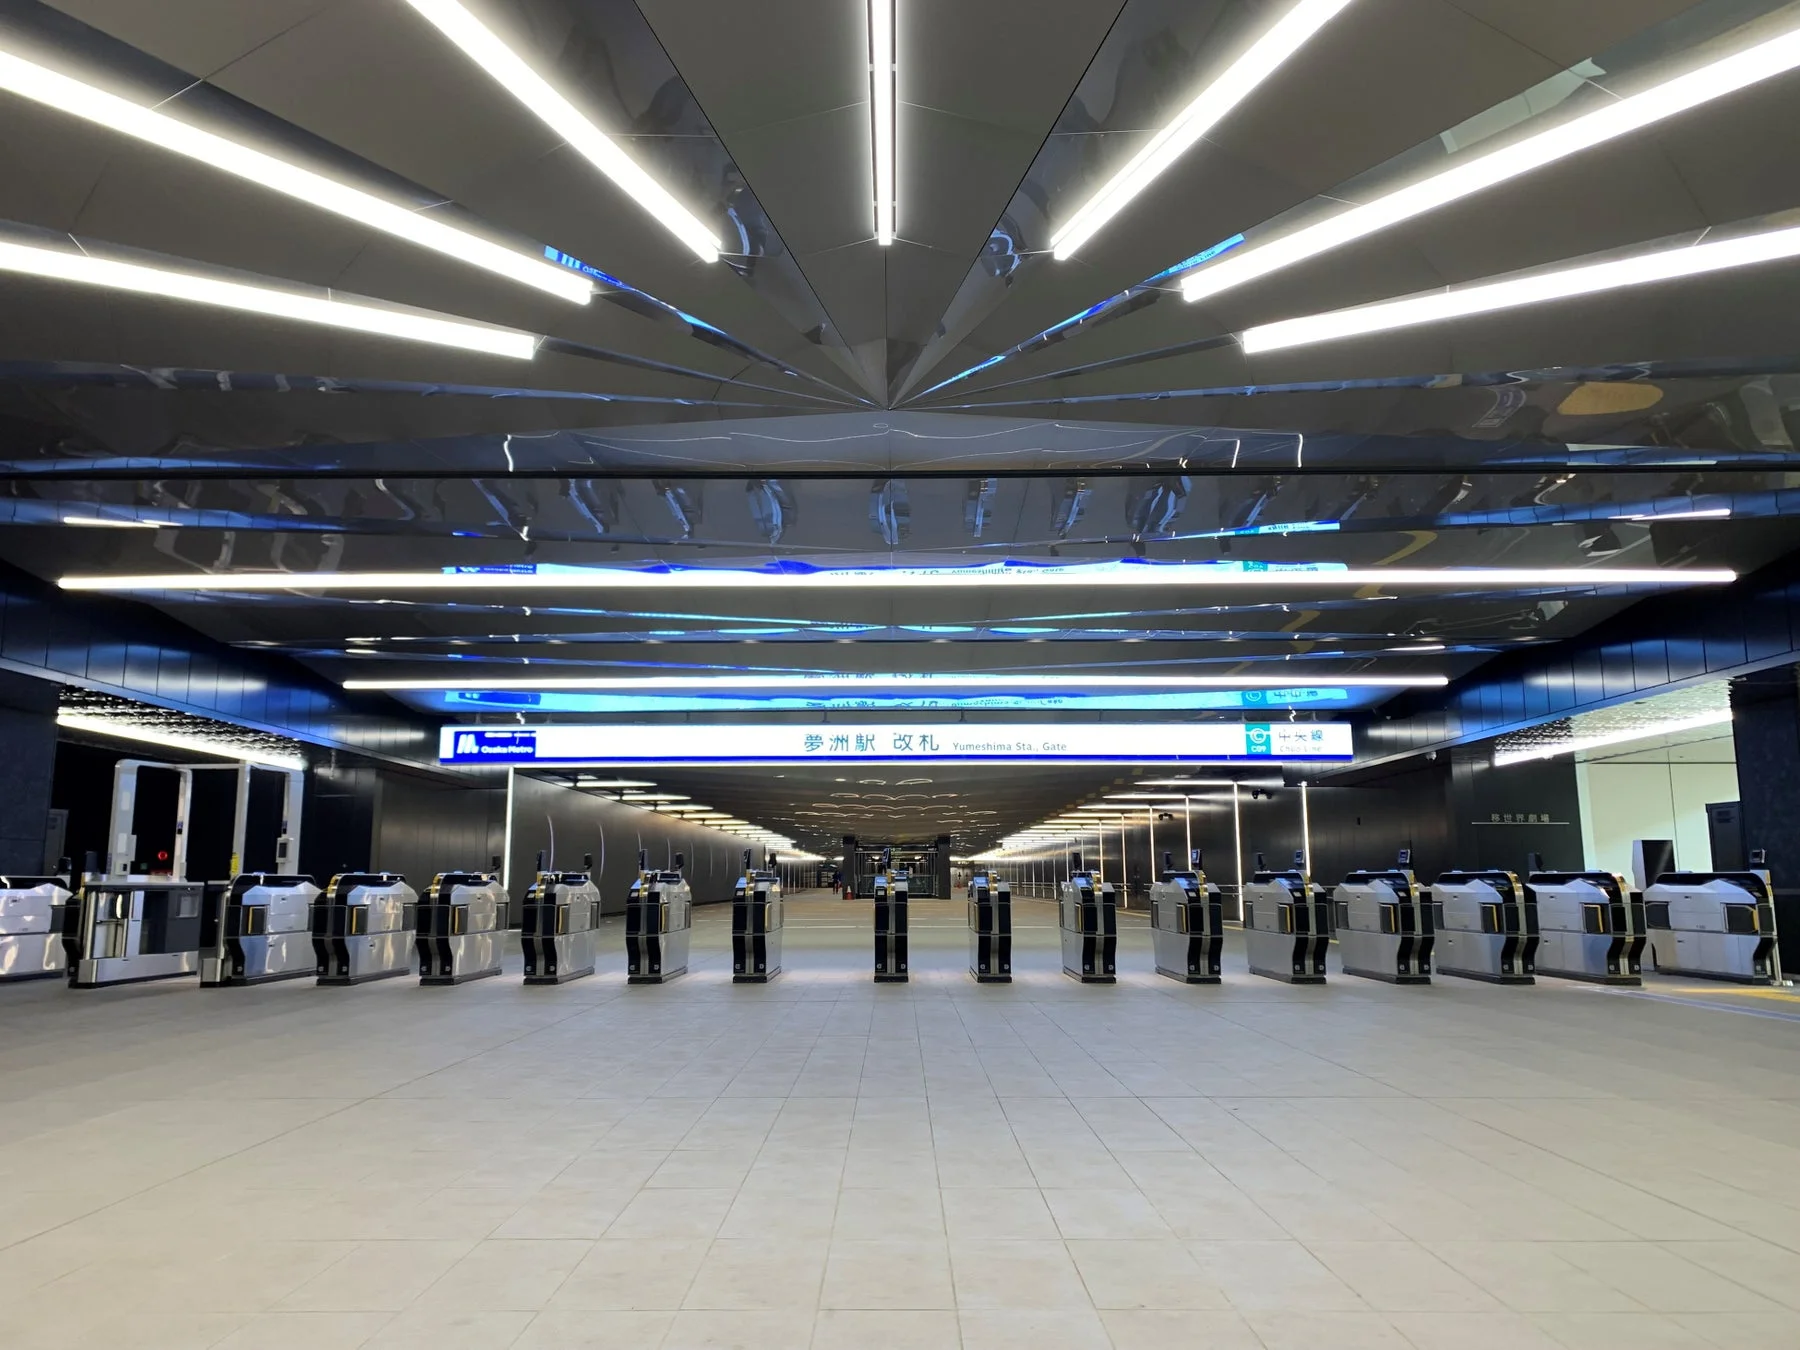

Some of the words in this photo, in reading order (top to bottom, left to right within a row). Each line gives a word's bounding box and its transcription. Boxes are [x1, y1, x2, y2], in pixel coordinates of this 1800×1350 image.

[803, 732, 876, 752] 夢洲駅
[892, 732, 940, 752] 改札
[953, 741, 1012, 751] Yumeshima
[1042, 742, 1068, 751] Gate
